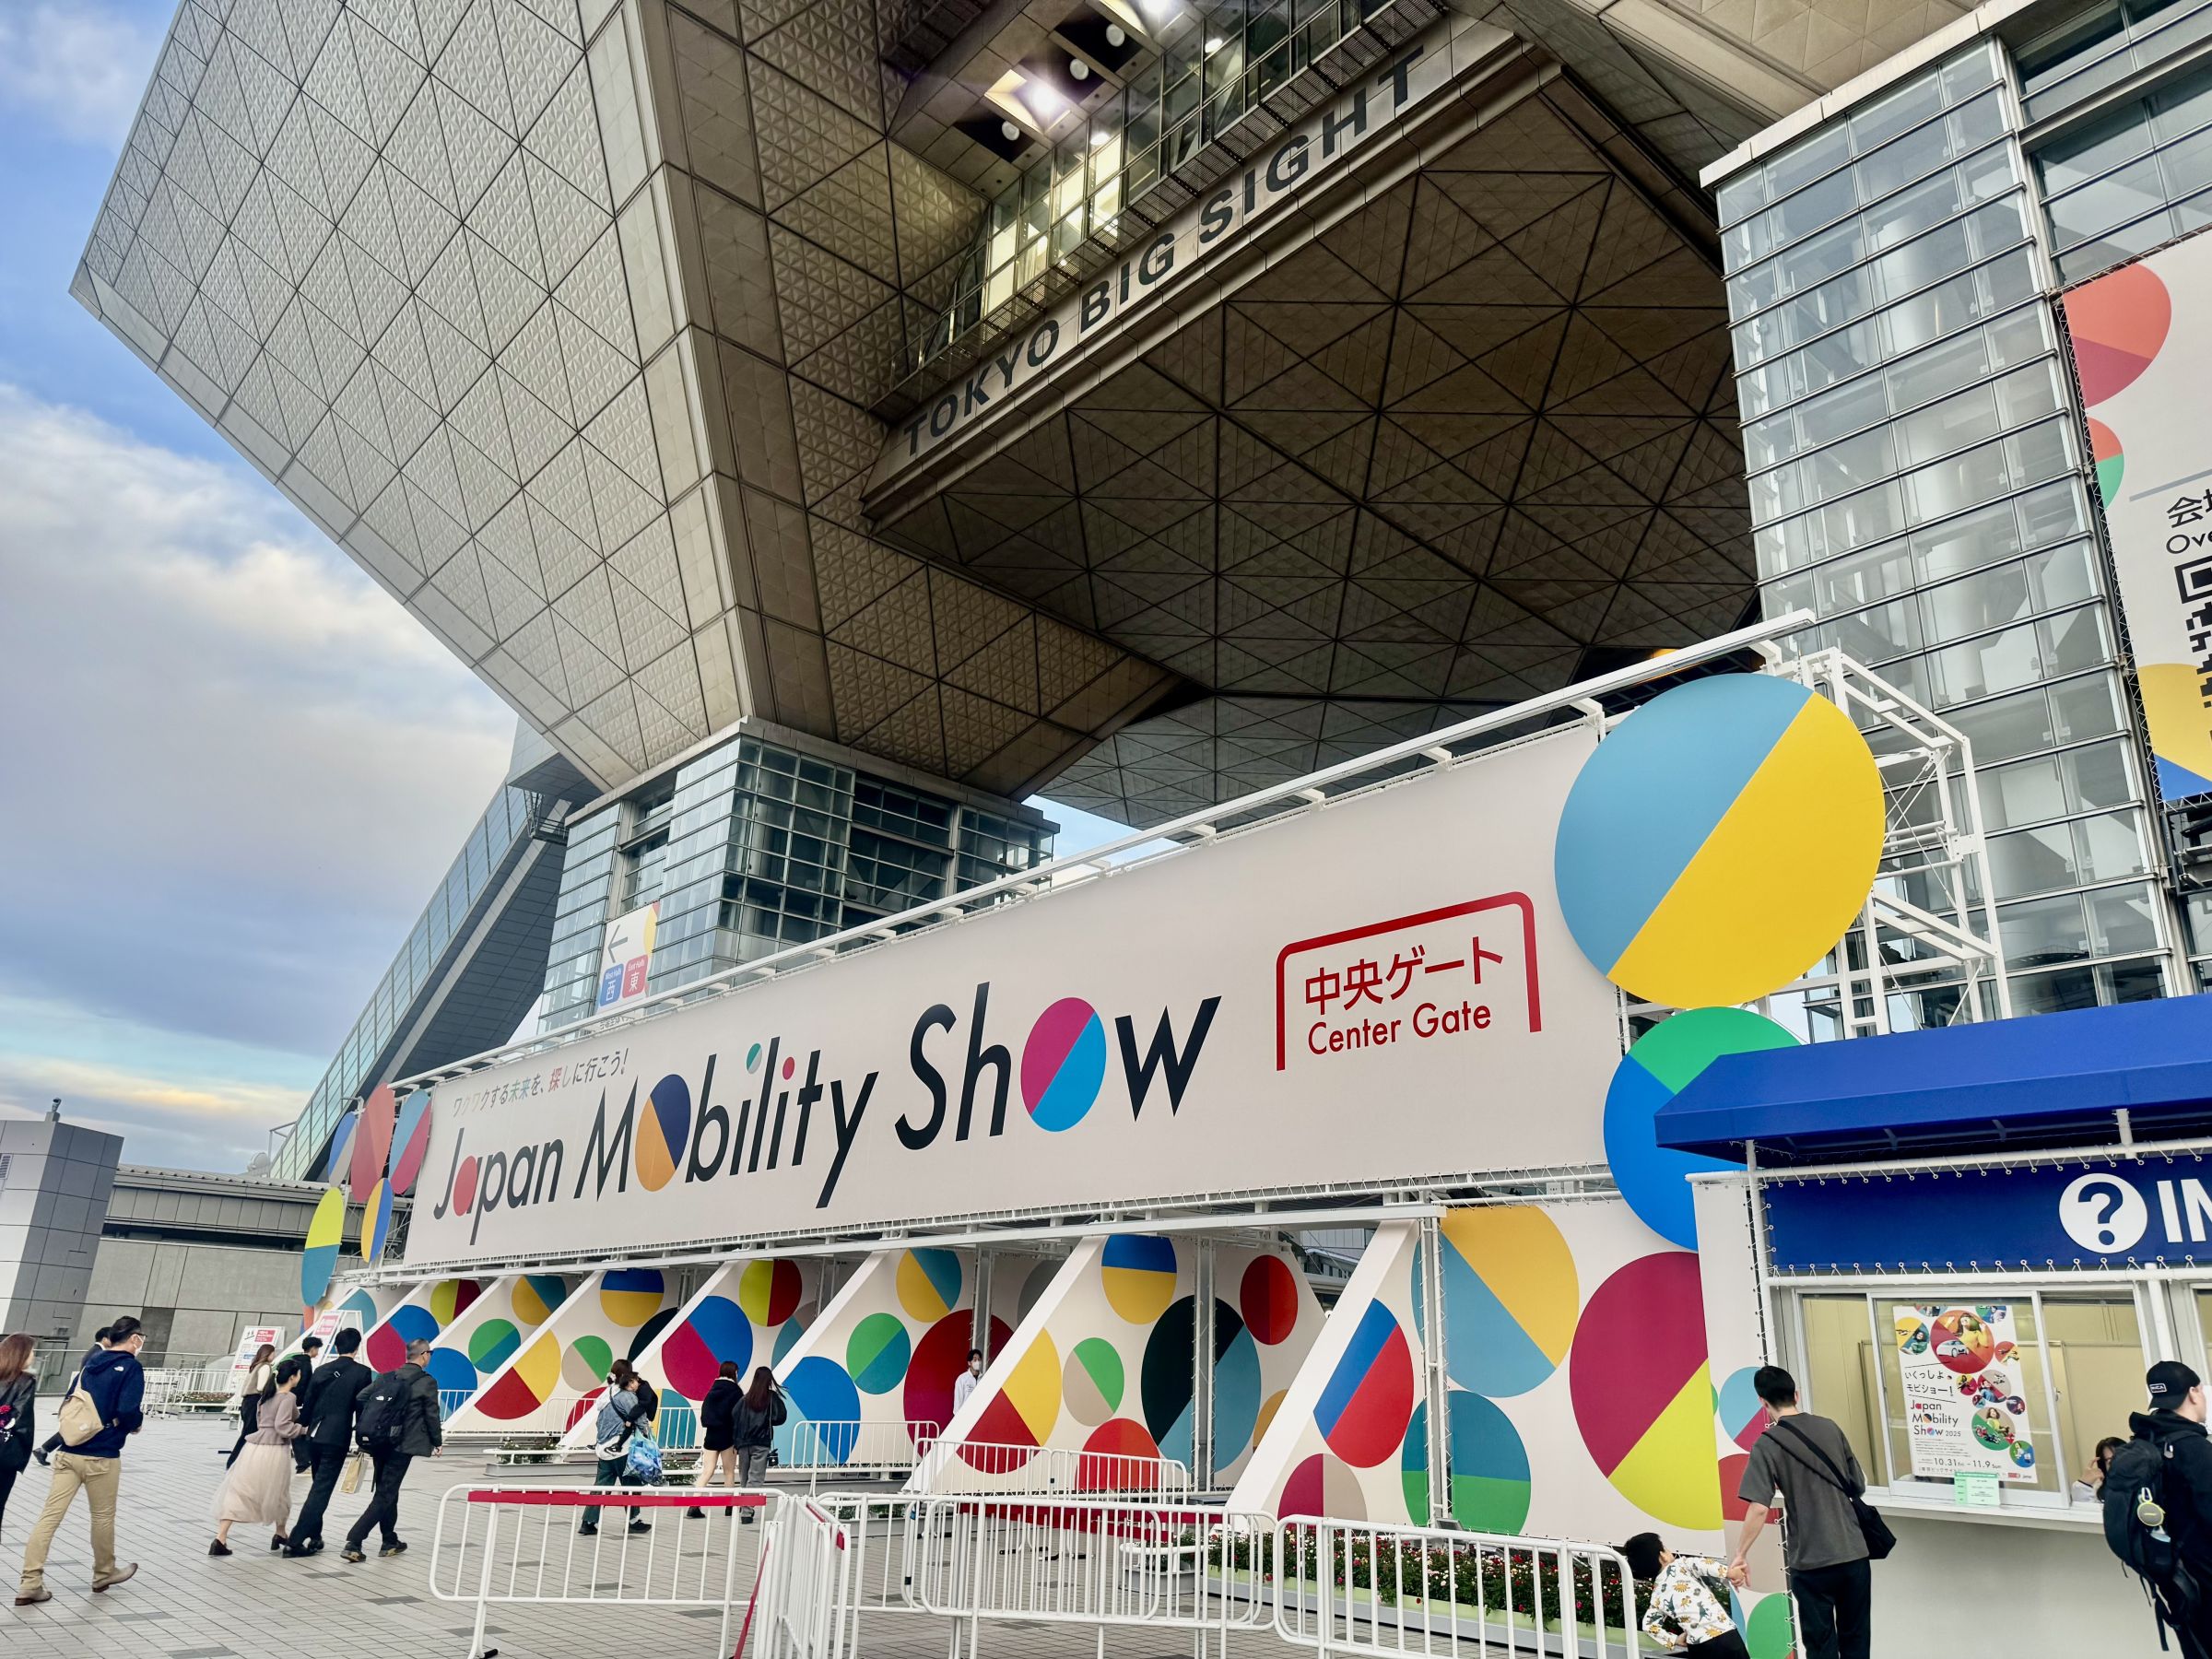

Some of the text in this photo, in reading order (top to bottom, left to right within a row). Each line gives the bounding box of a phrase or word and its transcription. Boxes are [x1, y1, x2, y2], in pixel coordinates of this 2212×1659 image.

[904, 45, 1424, 456] TOKYO BIG SIGHT
[2166, 488, 2212, 528] 会
[629, 971, 640, 993] 東
[1305, 936, 1503, 1015] 中央ゲート
[606, 980, 616, 1001] 西
[1308, 1000, 1491, 1055] Center Gate
[433, 982, 1222, 1246] Japan Mobility Show
[1910, 1400, 1942, 1412] Japan
[1912, 1413, 1959, 1427] Mobility
[1913, 1425, 1944, 1436] Show
[1935, 1457, 1957, 1466] 10.31
[1972, 1460, 1991, 1468] 11.9
